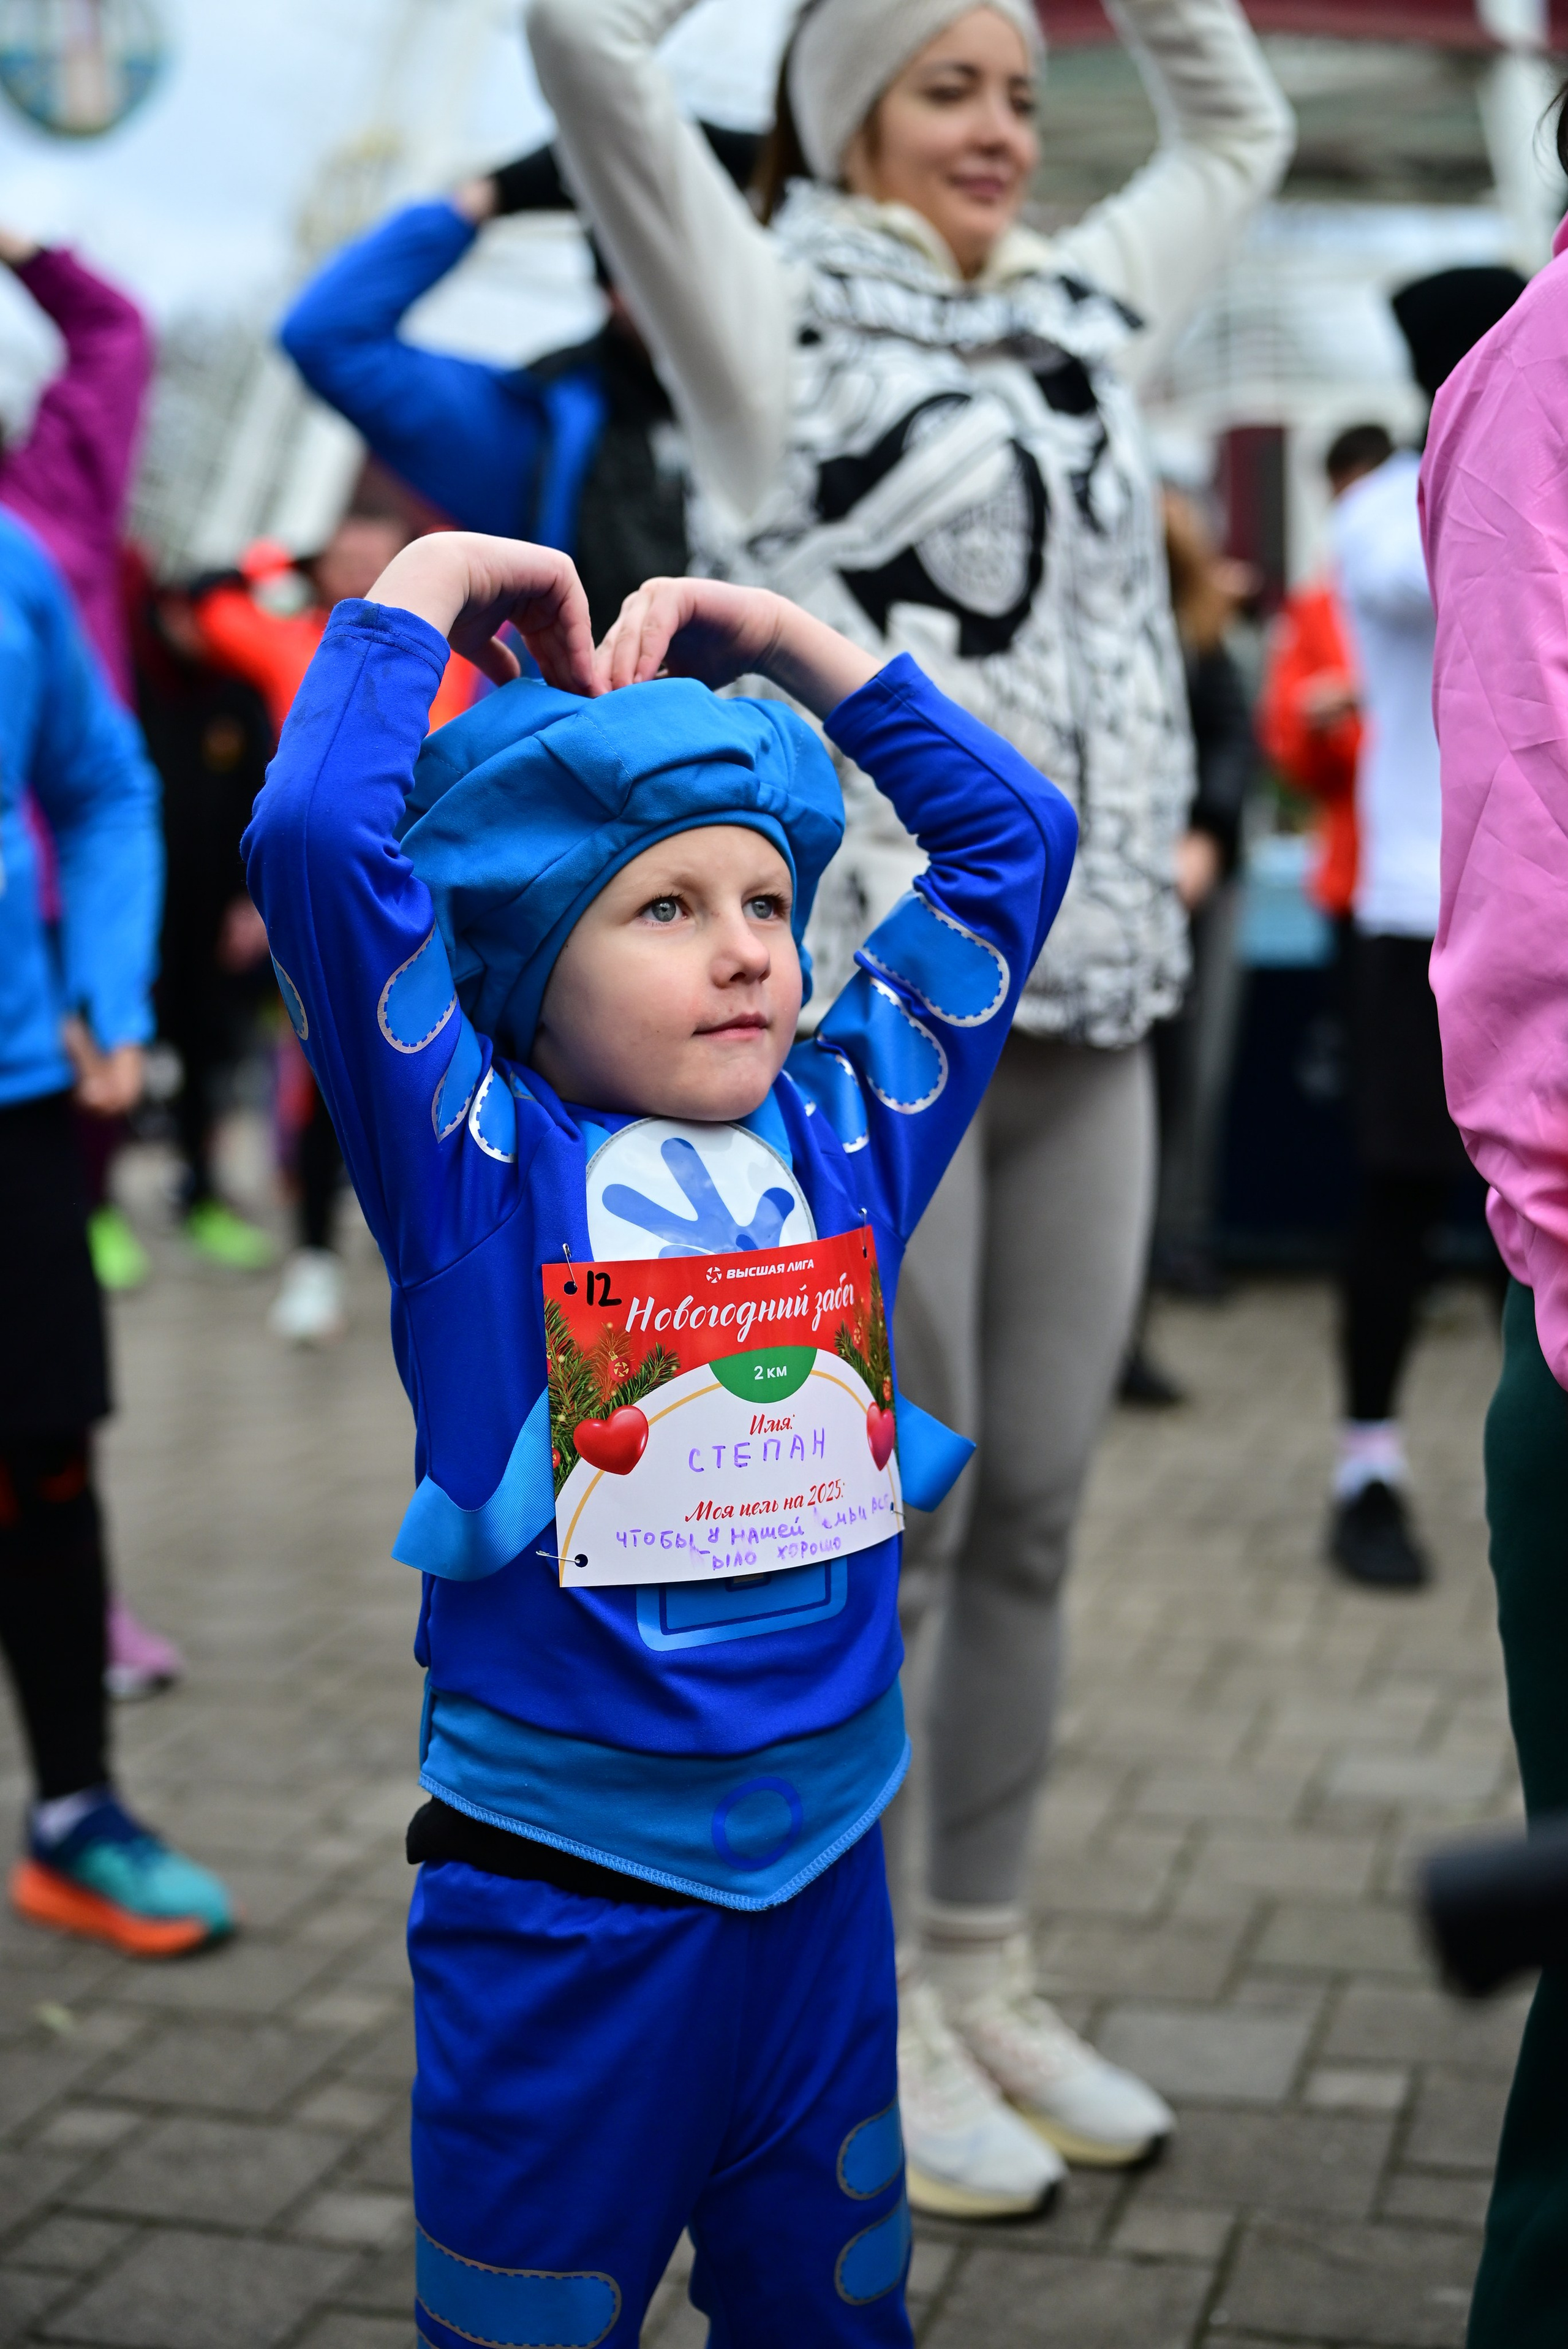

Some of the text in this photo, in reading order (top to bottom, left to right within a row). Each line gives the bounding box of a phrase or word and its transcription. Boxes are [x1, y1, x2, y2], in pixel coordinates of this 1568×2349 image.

[726, 1258, 815, 1279] ВЫСШАЯ ЛИГА
[586, 1270, 622, 1307] 12
[625, 1284, 809, 1343] Новогодний
[753, 1366, 764, 1380] 2
[749, 1413, 796, 1436] Имя:
[688, 1427, 825, 1473] СТЕПАН
[684, 1478, 845, 1522] Моя цель на 2025:
[616, 1529, 695, 1550] ЧТОБЫ
